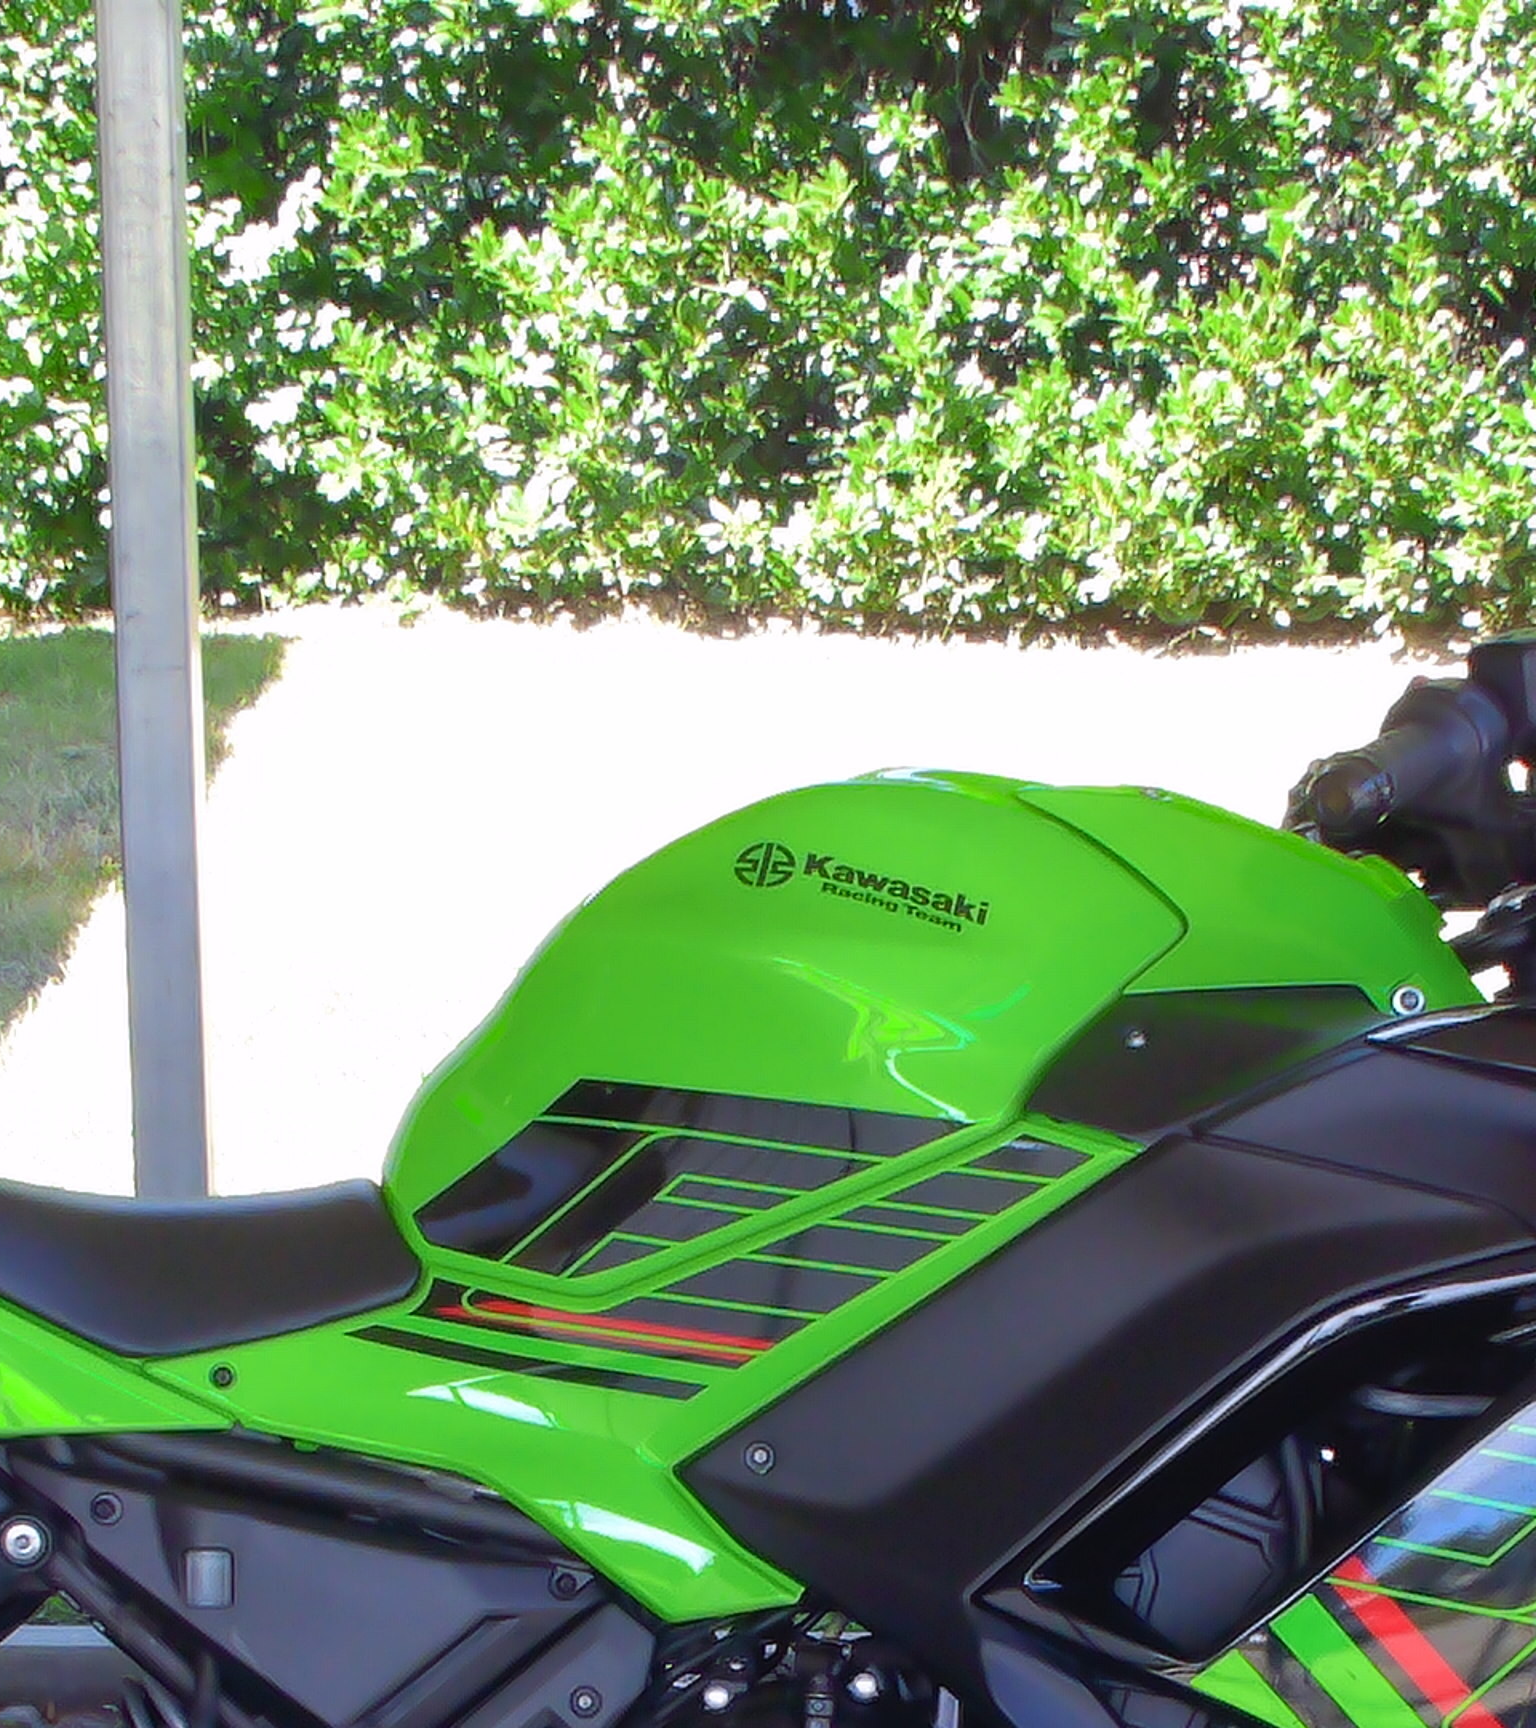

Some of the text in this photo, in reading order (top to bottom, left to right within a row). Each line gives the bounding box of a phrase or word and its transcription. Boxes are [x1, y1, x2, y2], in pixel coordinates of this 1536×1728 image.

[804, 853, 989, 925] Kawasaki
[821, 882, 962, 932] Racing Team
